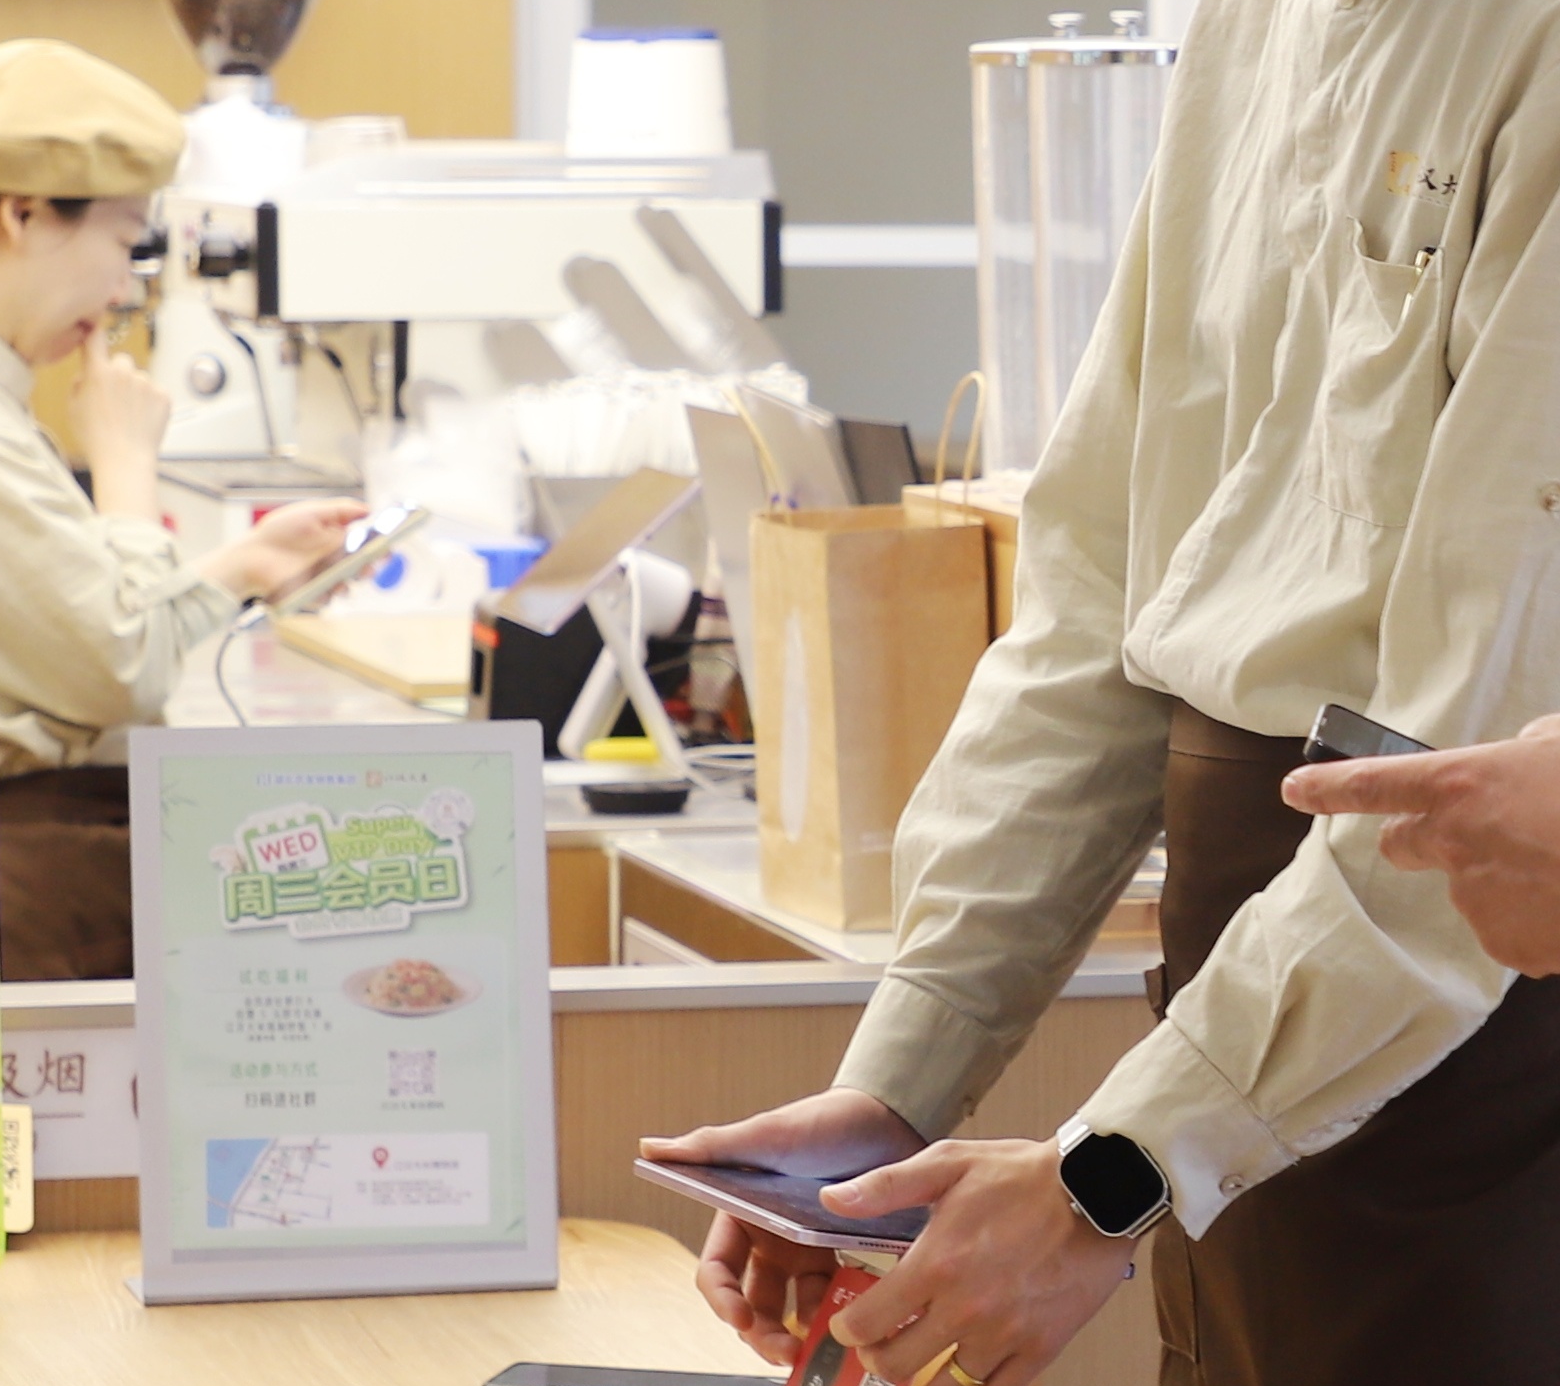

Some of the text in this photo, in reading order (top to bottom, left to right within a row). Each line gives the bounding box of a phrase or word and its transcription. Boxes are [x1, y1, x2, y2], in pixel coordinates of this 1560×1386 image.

[258, 831, 318, 863] WED
[224, 856, 460, 923] 周三会员日
